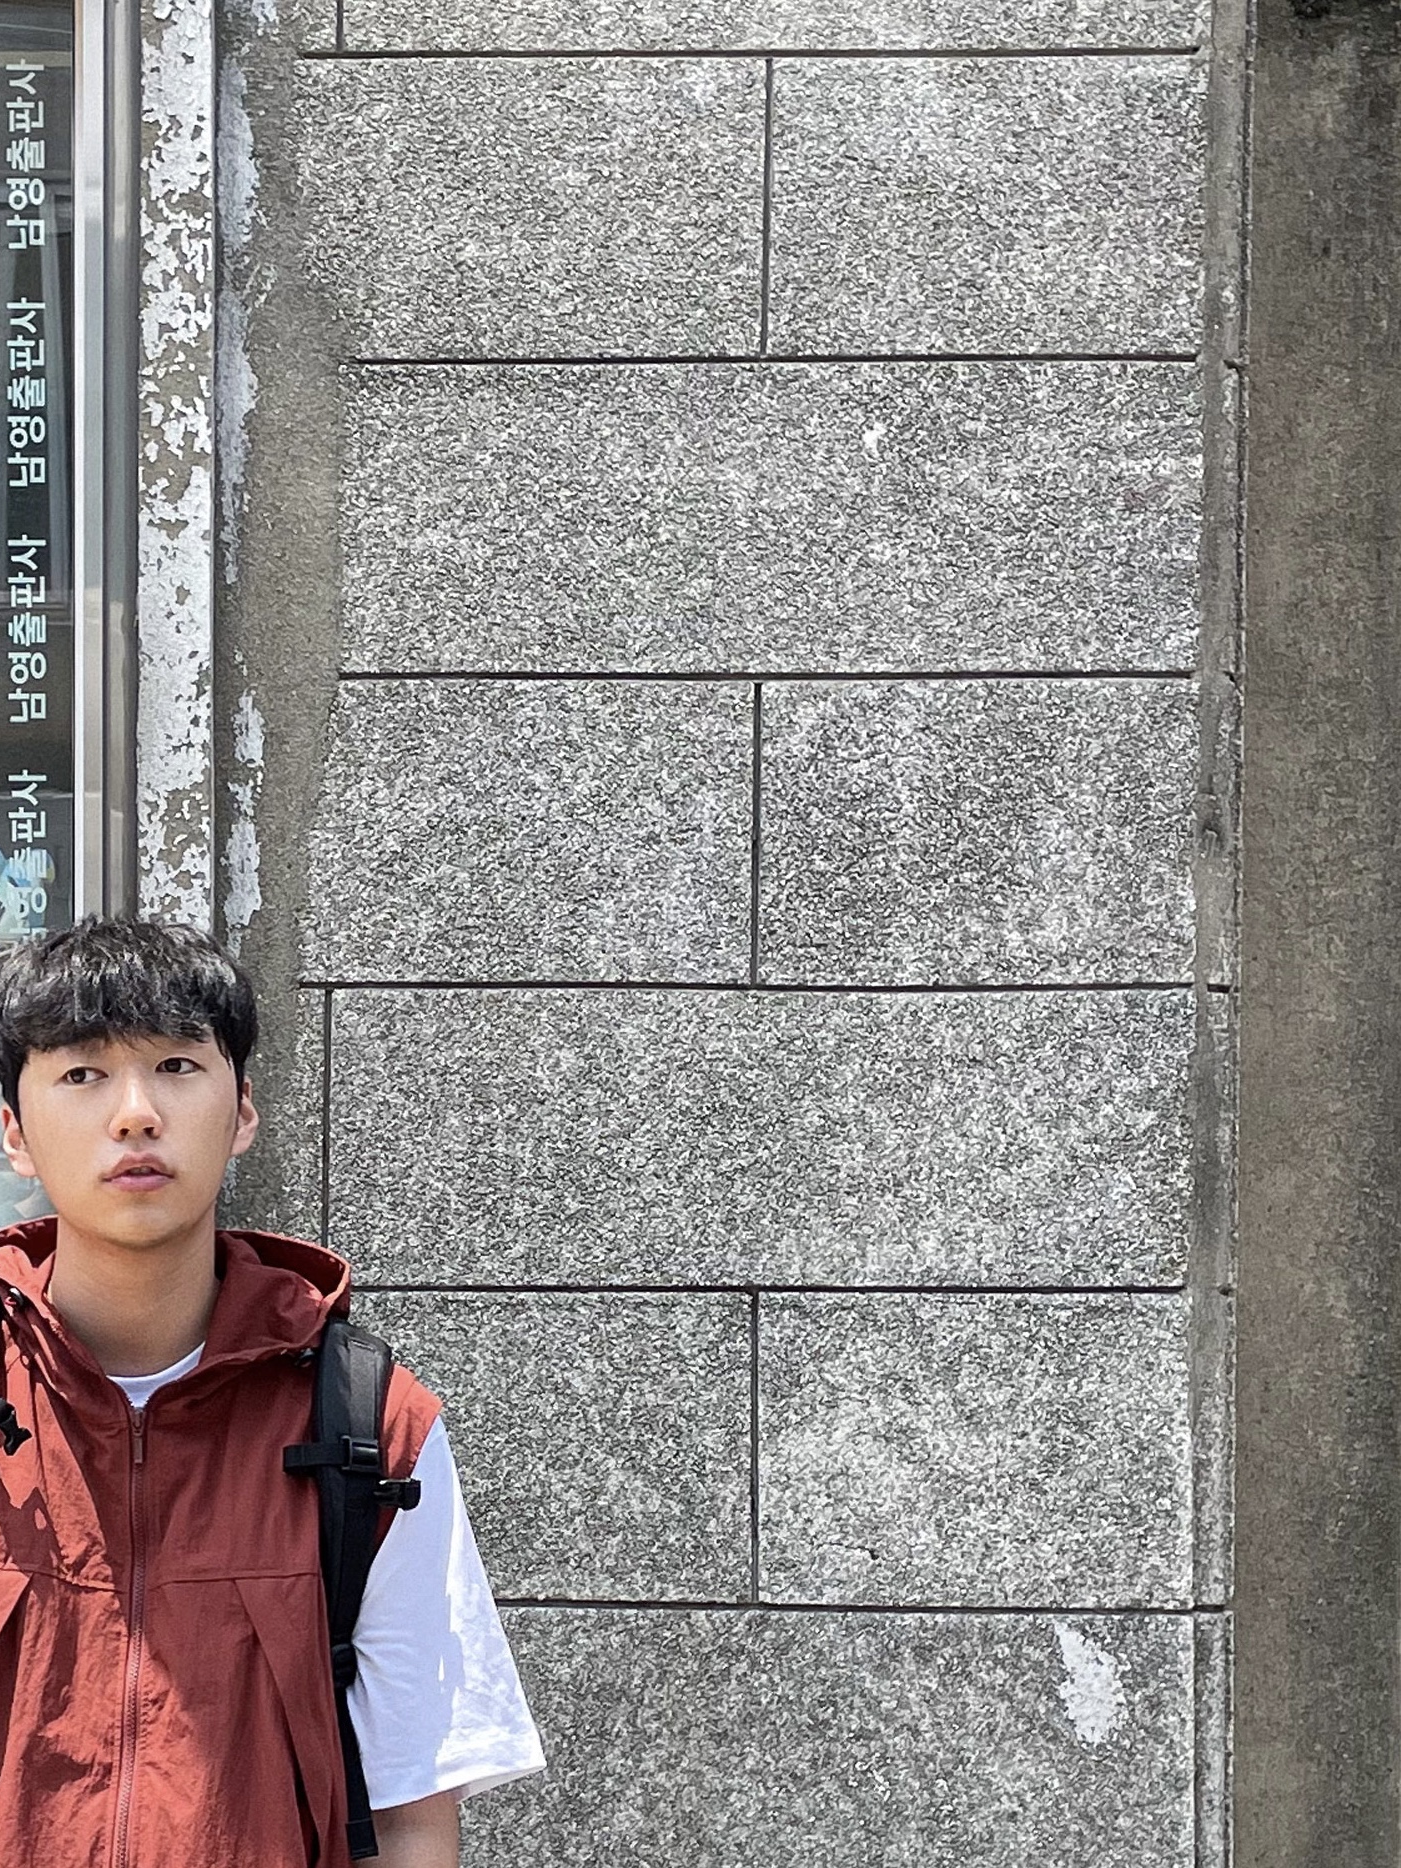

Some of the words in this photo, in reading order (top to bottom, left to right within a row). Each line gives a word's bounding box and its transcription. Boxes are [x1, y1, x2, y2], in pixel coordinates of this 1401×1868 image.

[6, 58, 45, 250] 남영출판사
[7, 297, 46, 487] 남영출판사
[7, 534, 47, 723] 남영출판사
